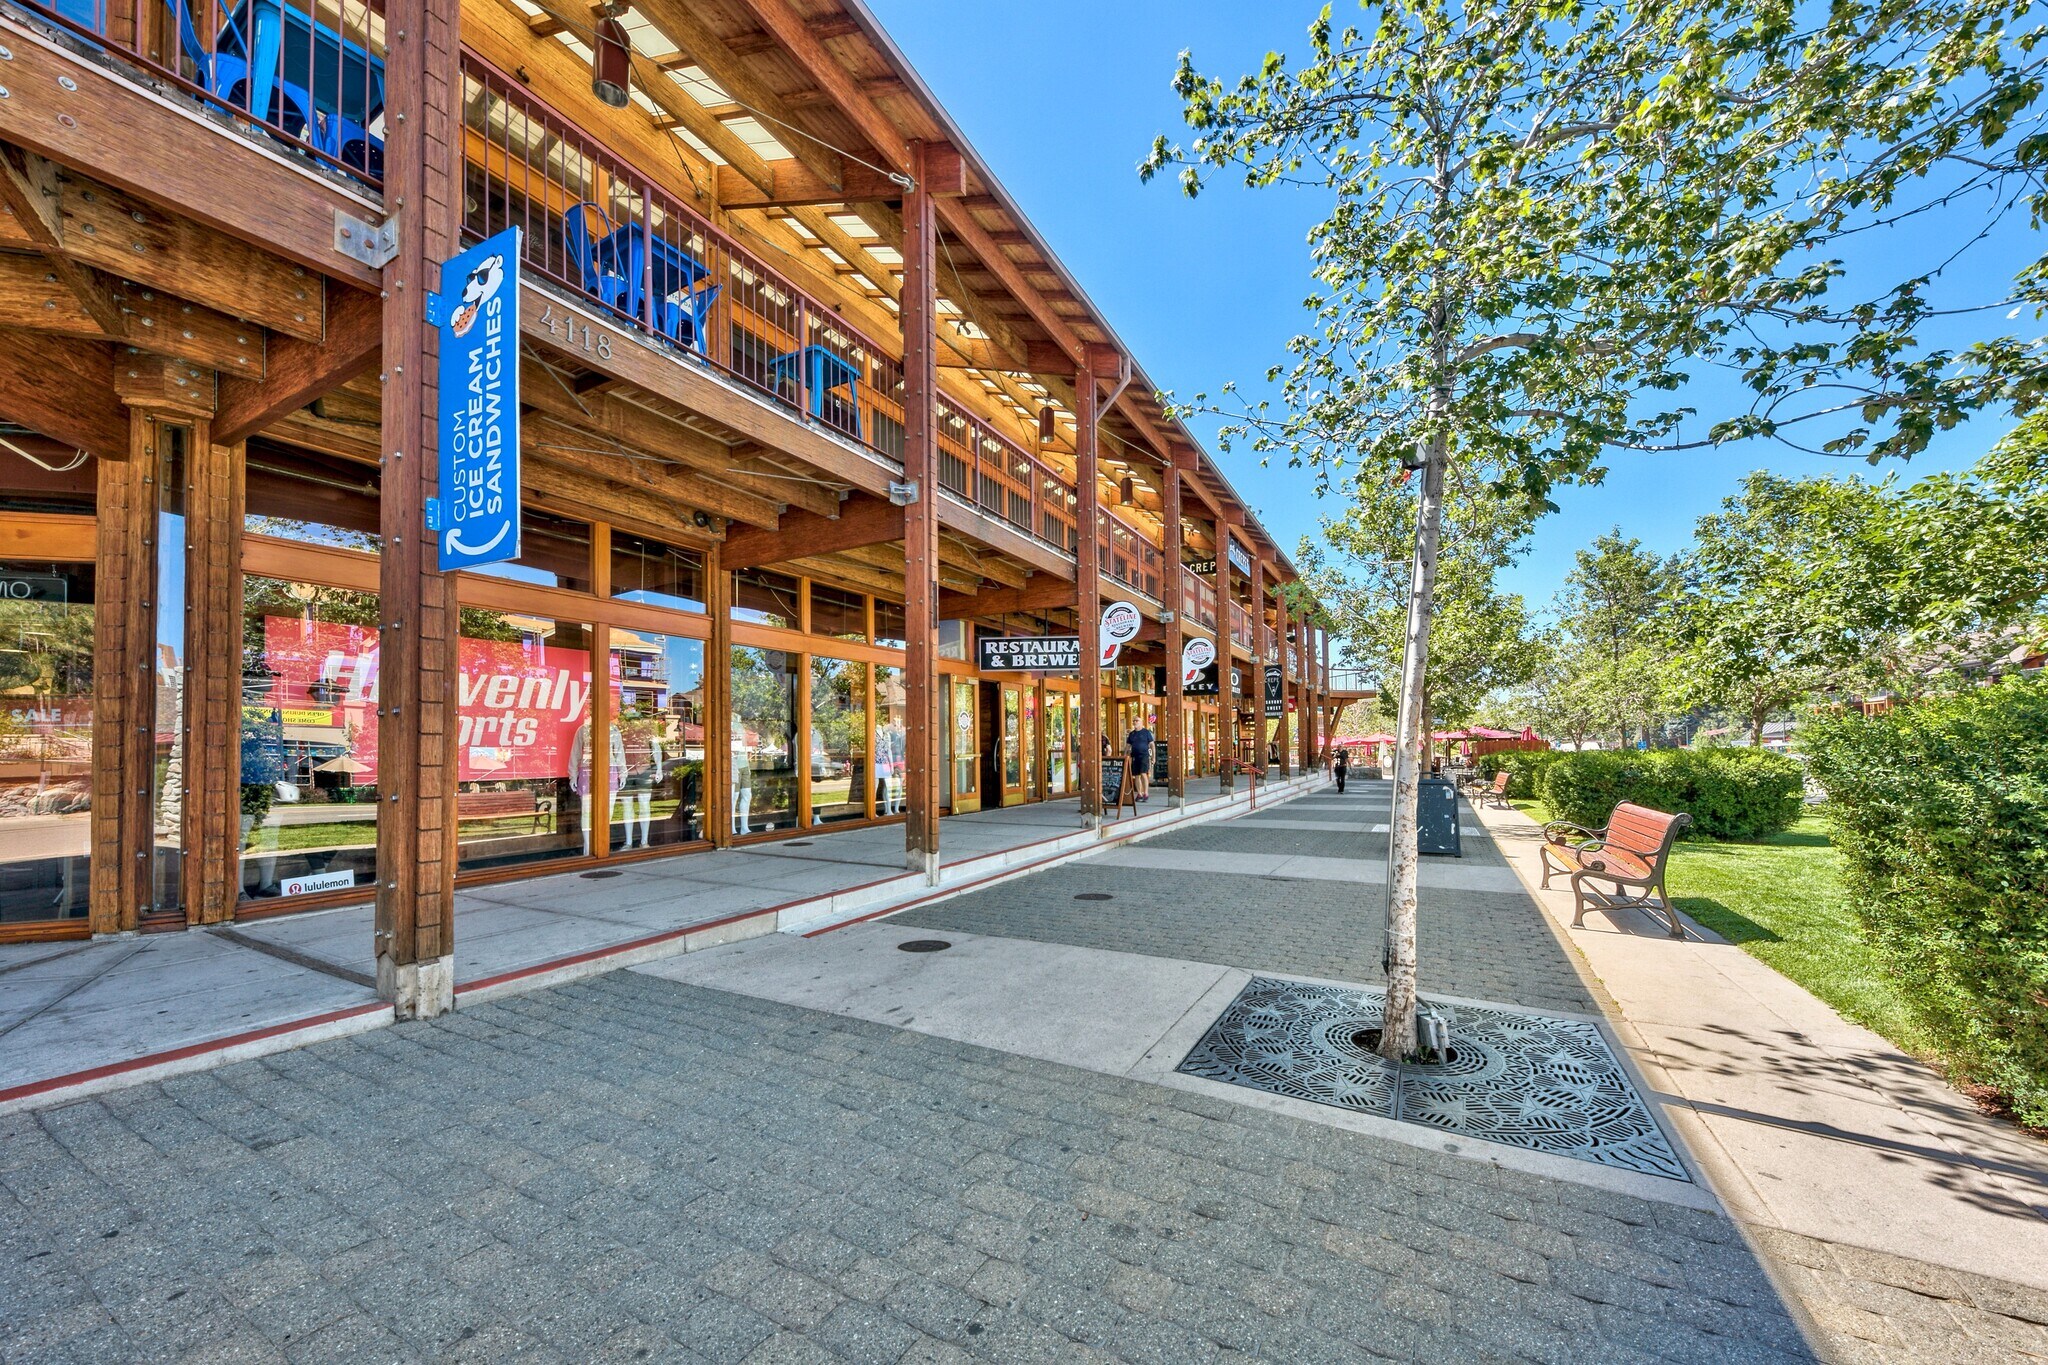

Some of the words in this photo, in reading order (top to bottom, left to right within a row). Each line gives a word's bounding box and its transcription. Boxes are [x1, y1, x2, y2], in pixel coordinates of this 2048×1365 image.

[540, 304, 612, 360] 4118
[469, 347, 484, 461] CREAM
[486, 297, 502, 514] SANDWICHES
[453, 409, 466, 522] CUSTOM
[469, 466, 484, 518] ICE
[1104, 613, 1137, 628] STATELINE
[985, 640, 1080, 654] RESTAURA
[990, 654, 1006, 668] &
[1012, 653, 1080, 667] BREWE
[318, 650, 592, 722] Hvenly
[11, 708, 62, 723] SALE
[304, 878, 350, 892] lululemon
